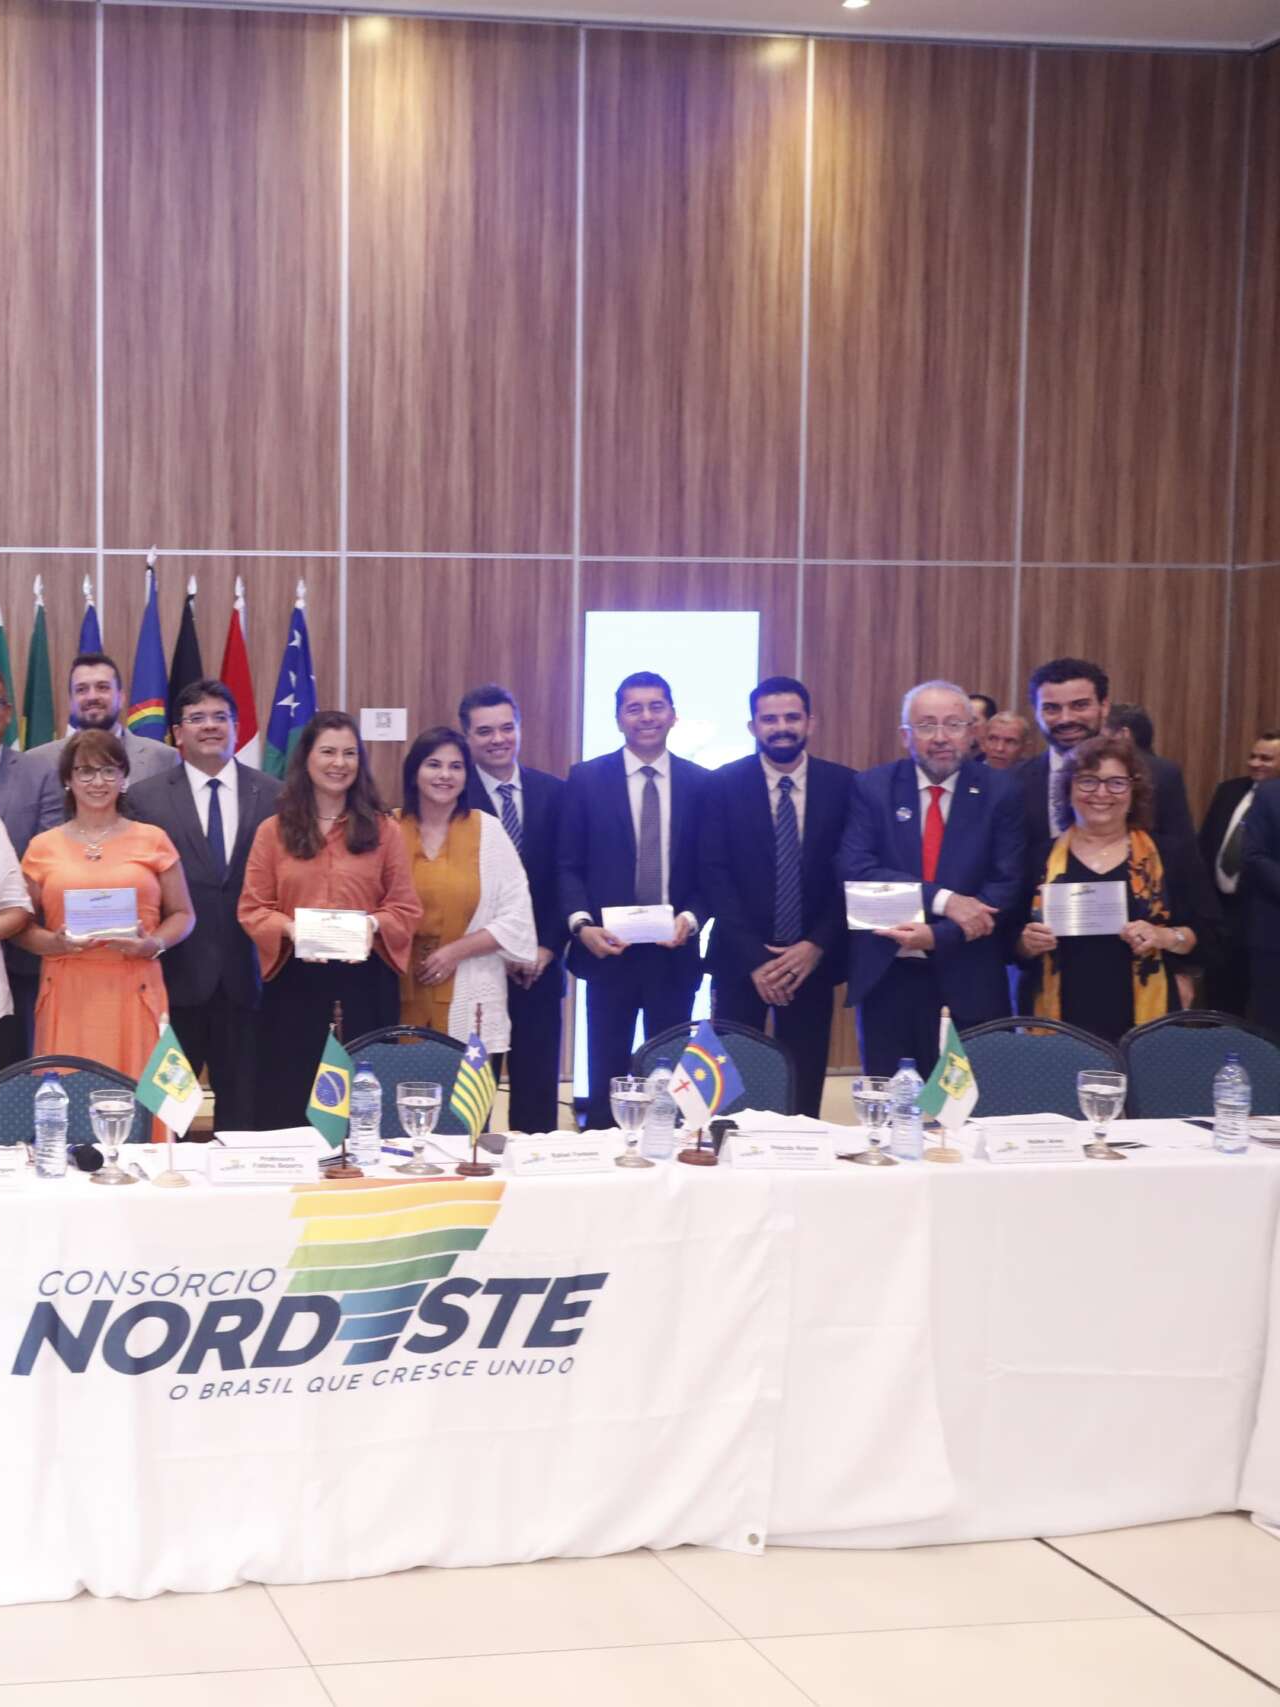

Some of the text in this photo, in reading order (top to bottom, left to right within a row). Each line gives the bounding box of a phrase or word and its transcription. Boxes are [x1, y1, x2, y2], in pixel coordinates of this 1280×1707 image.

[38, 1266, 276, 1297] CONSÓRCIO
[10, 1272, 611, 1376] NORDESTE
[169, 1356, 575, 1400] O BRASIL QUE CRESCE UNIDO
